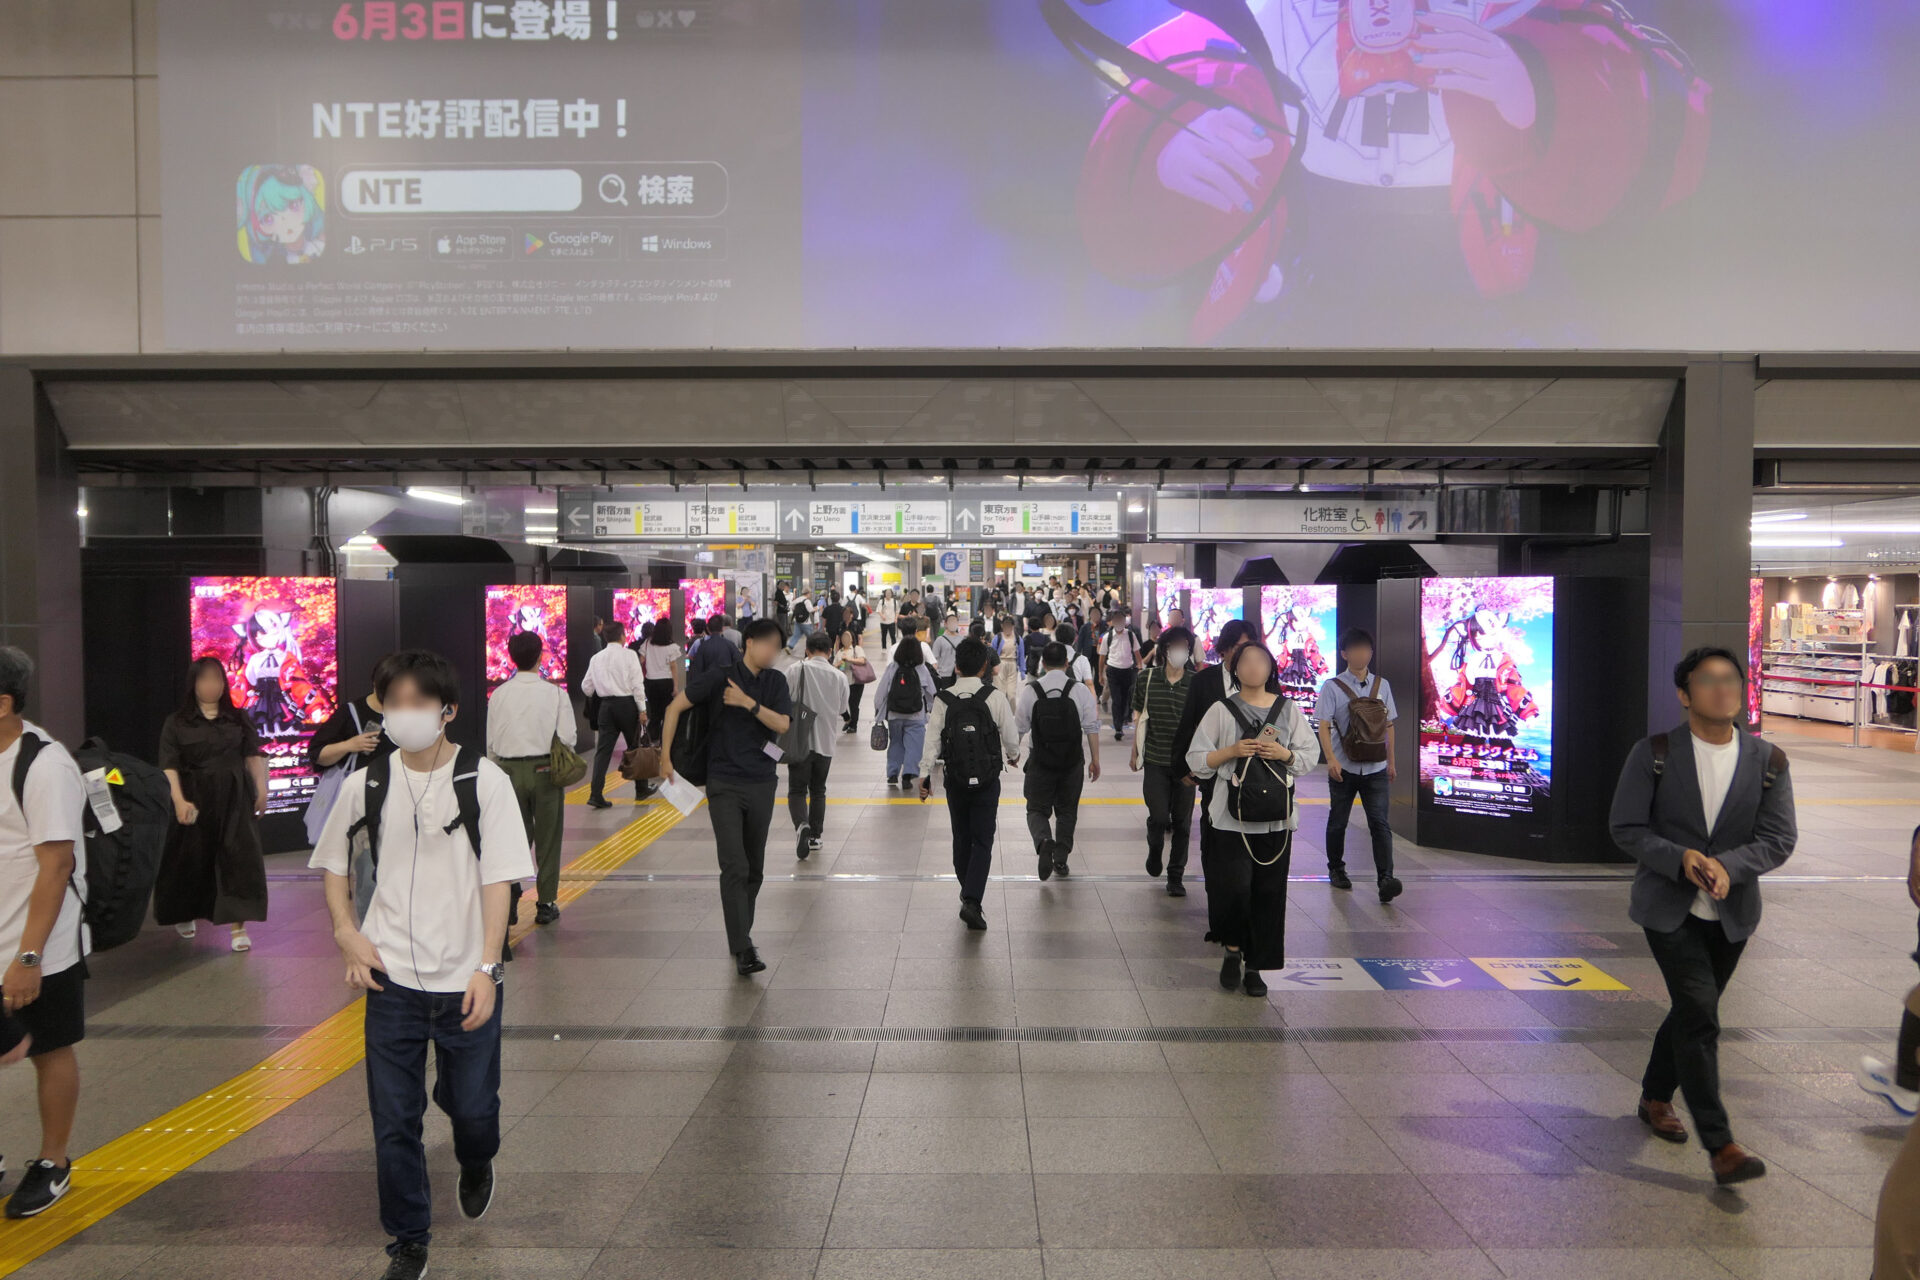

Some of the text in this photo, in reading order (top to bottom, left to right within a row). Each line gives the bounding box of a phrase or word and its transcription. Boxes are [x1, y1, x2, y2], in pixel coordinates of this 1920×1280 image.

[332, 1, 619, 41] 6月3日に登場！
[312, 98, 628, 139] NTE好評配信中！
[359, 178, 422, 205] NTE
[637, 175, 694, 205] 検索
[455, 234, 506, 246] App Store
[548, 231, 614, 247] Google Play
[661, 236, 712, 249] Windows
[370, 238, 418, 252] PS5
[596, 505, 631, 515] 新宿方面
[644, 504, 651, 513] 5
[738, 504, 744, 513] 6
[813, 504, 846, 515] 上野方面
[861, 504, 866, 513] 1
[905, 503, 911, 513] 2
[984, 504, 1017, 514] 東京方面
[1032, 503, 1038, 513] 3
[1080, 504, 1087, 513] 4
[1303, 507, 1348, 522] 化粧室
[1301, 524, 1348, 533] Restrooms
[1478, 745, 1539, 761] レクイエム
